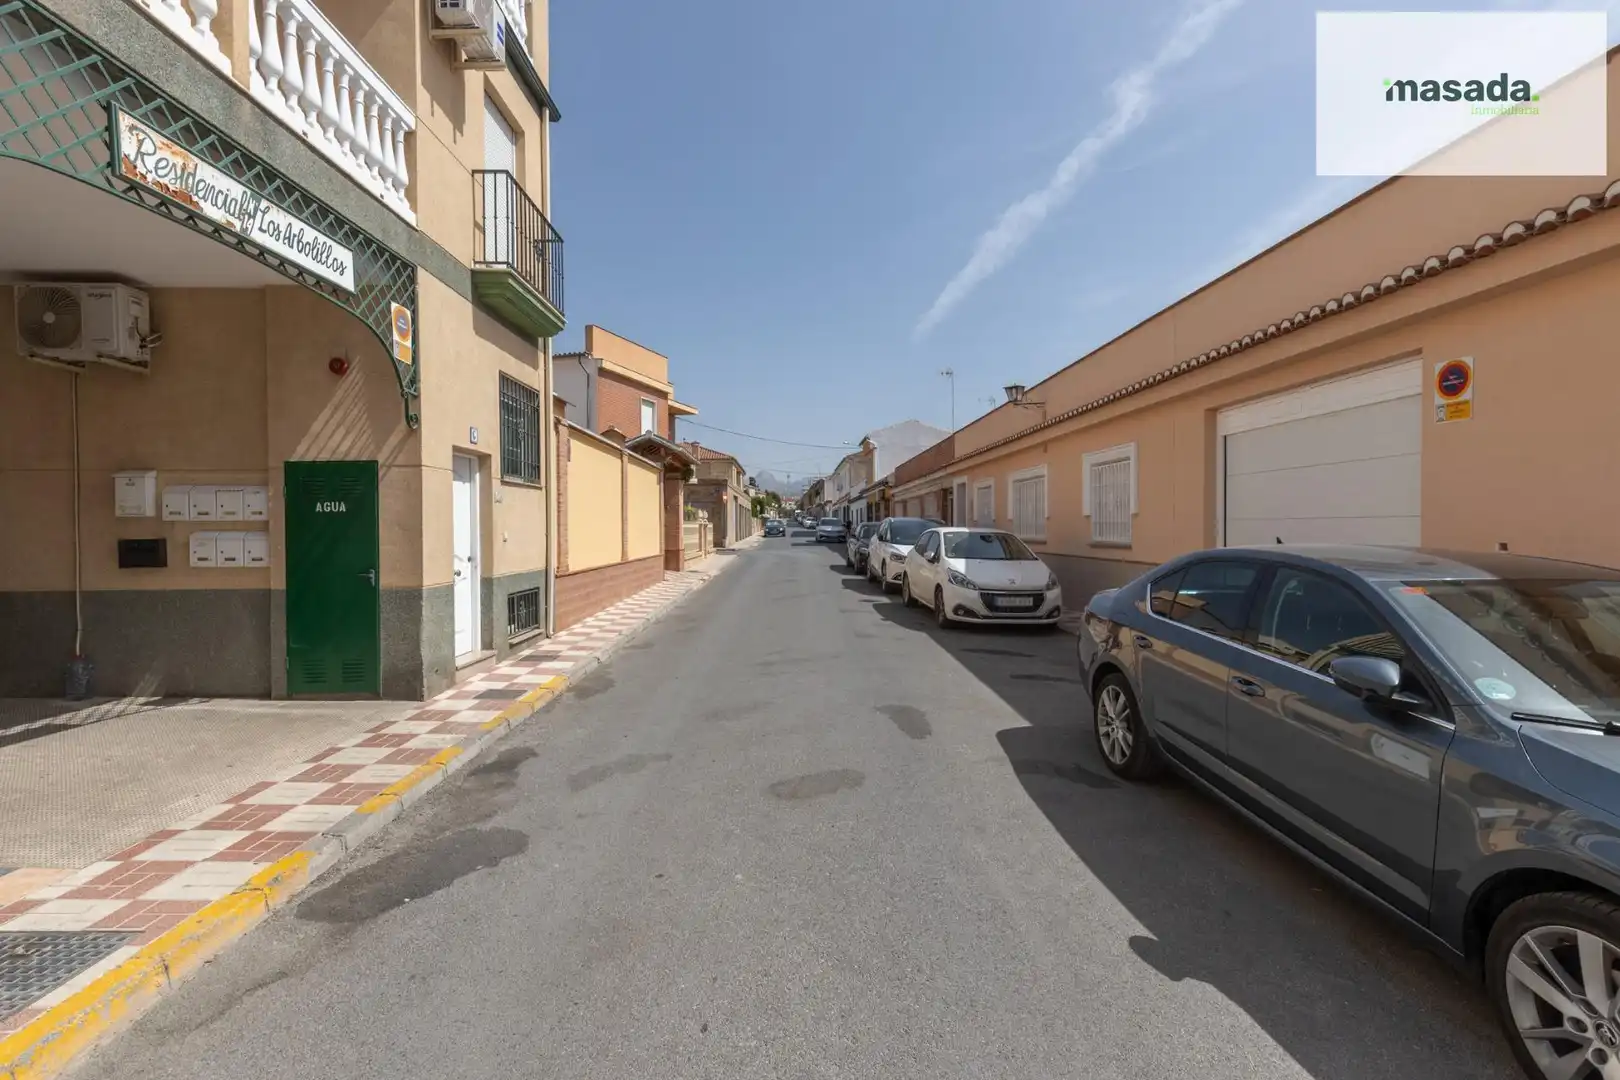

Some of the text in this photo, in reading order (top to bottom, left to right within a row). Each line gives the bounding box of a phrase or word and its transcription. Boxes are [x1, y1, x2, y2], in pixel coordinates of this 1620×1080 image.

[128, 123, 347, 276] Residencial Los Arbolillos
[315, 501, 347, 512] AGUA
